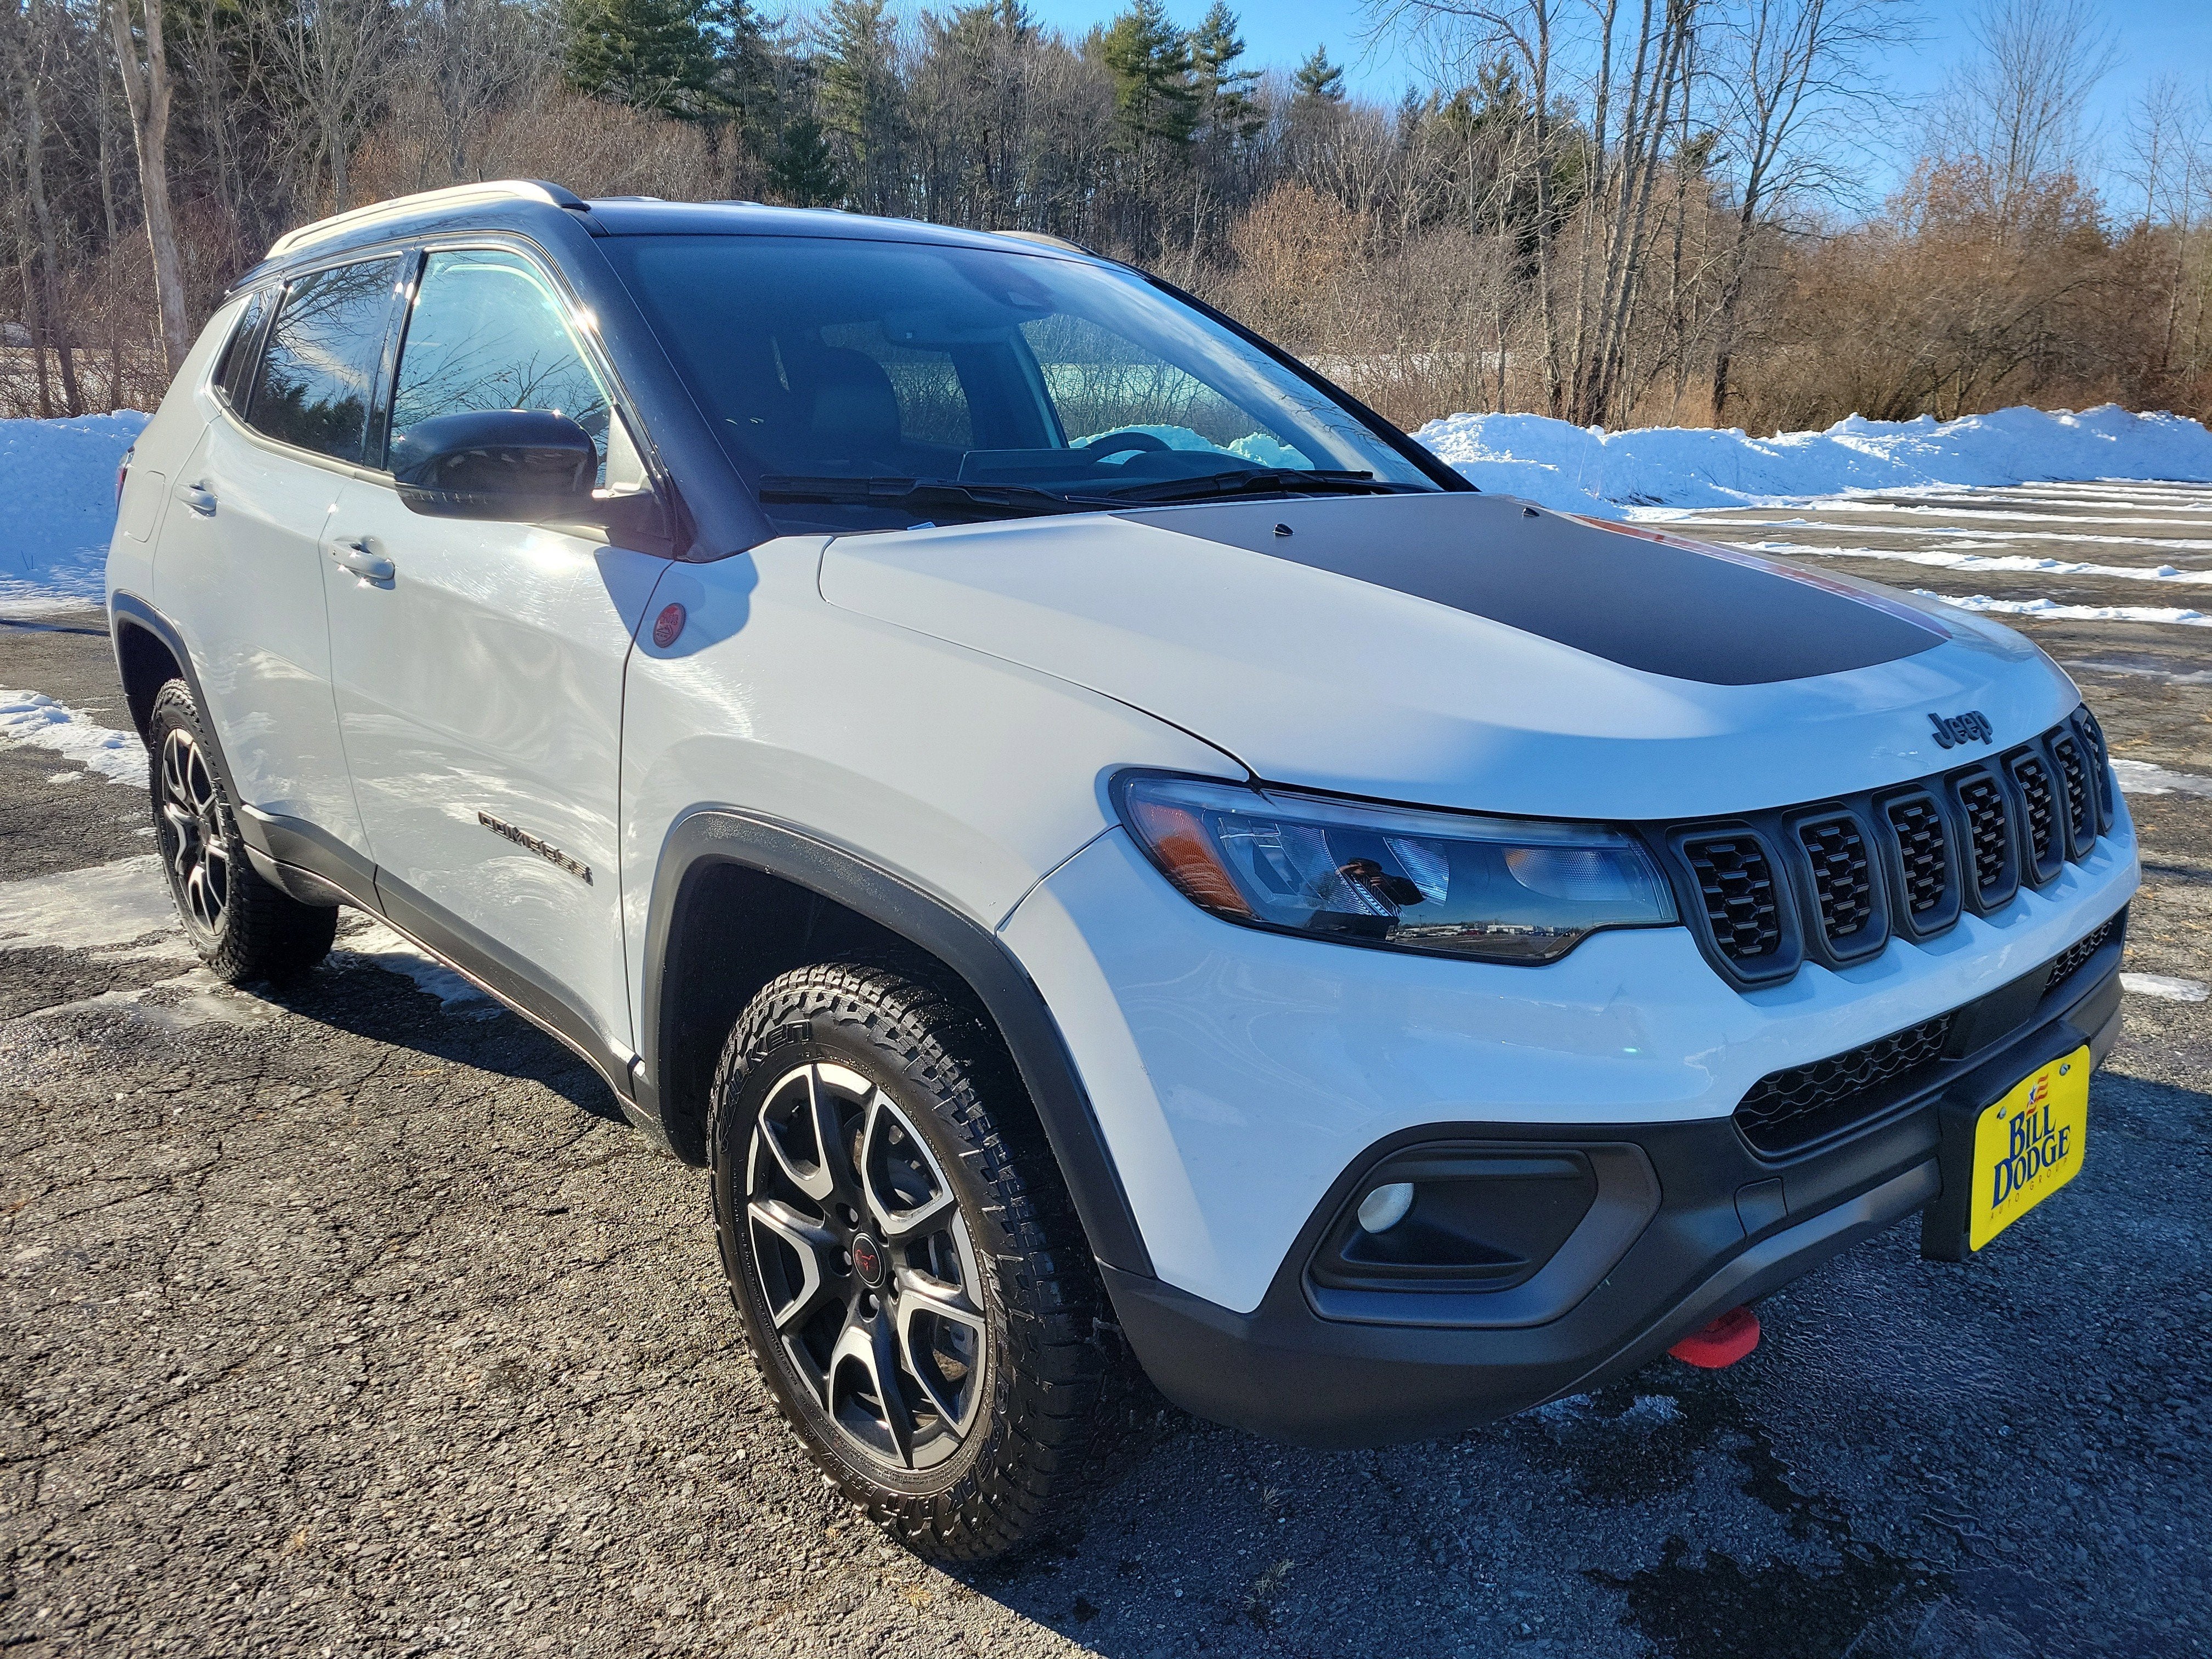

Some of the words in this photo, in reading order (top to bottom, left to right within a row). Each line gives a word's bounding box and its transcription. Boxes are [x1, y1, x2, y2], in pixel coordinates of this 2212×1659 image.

[1928, 710, 1993, 749] Jeep
[2009, 1103, 2056, 1162] BILL
[1991, 1125, 2070, 1210] DODGE
